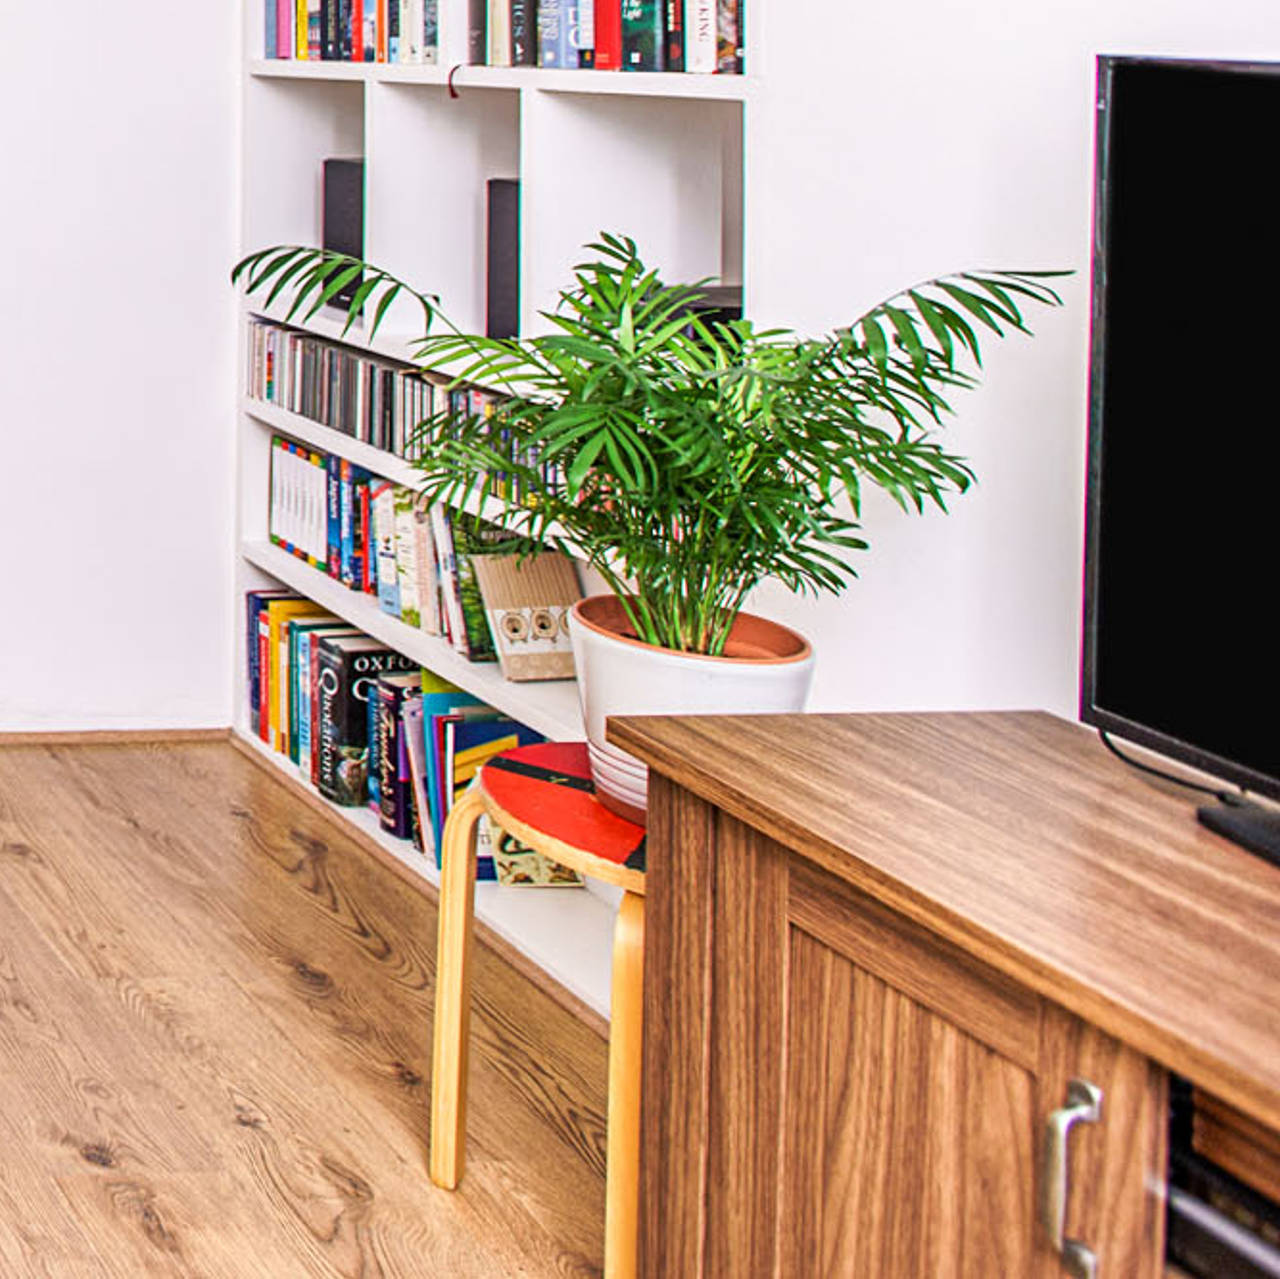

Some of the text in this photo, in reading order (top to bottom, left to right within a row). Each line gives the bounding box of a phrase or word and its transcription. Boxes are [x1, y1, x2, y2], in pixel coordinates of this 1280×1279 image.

[698, 7, 709, 43] KING
[328, 477, 339, 519] Japan
[354, 655, 420, 671] OXFO
[319, 668, 339, 782] Quotations
